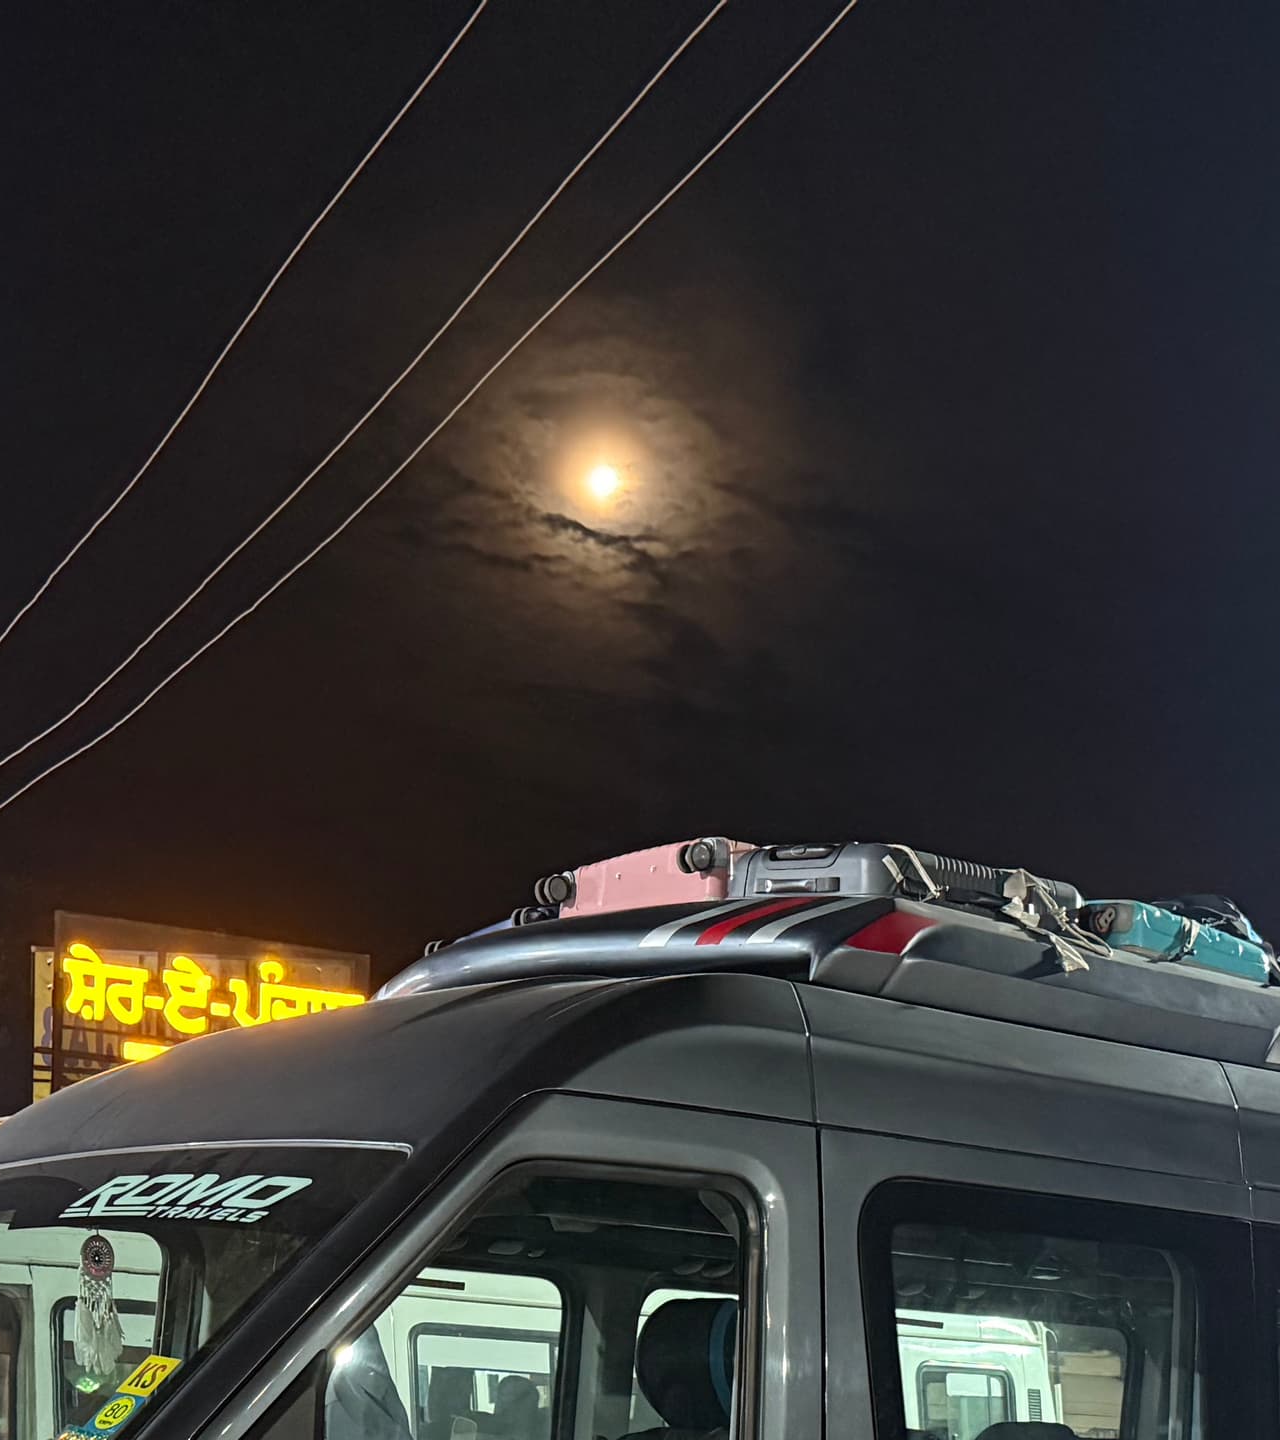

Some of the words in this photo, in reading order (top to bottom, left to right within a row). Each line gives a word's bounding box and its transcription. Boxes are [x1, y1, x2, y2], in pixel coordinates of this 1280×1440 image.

[58, 1174, 313, 1218] ROMO
[147, 1206, 269, 1223] TRAVELS
[127, 1362, 168, 1389] KS
[104, 1403, 129, 1419] 80
